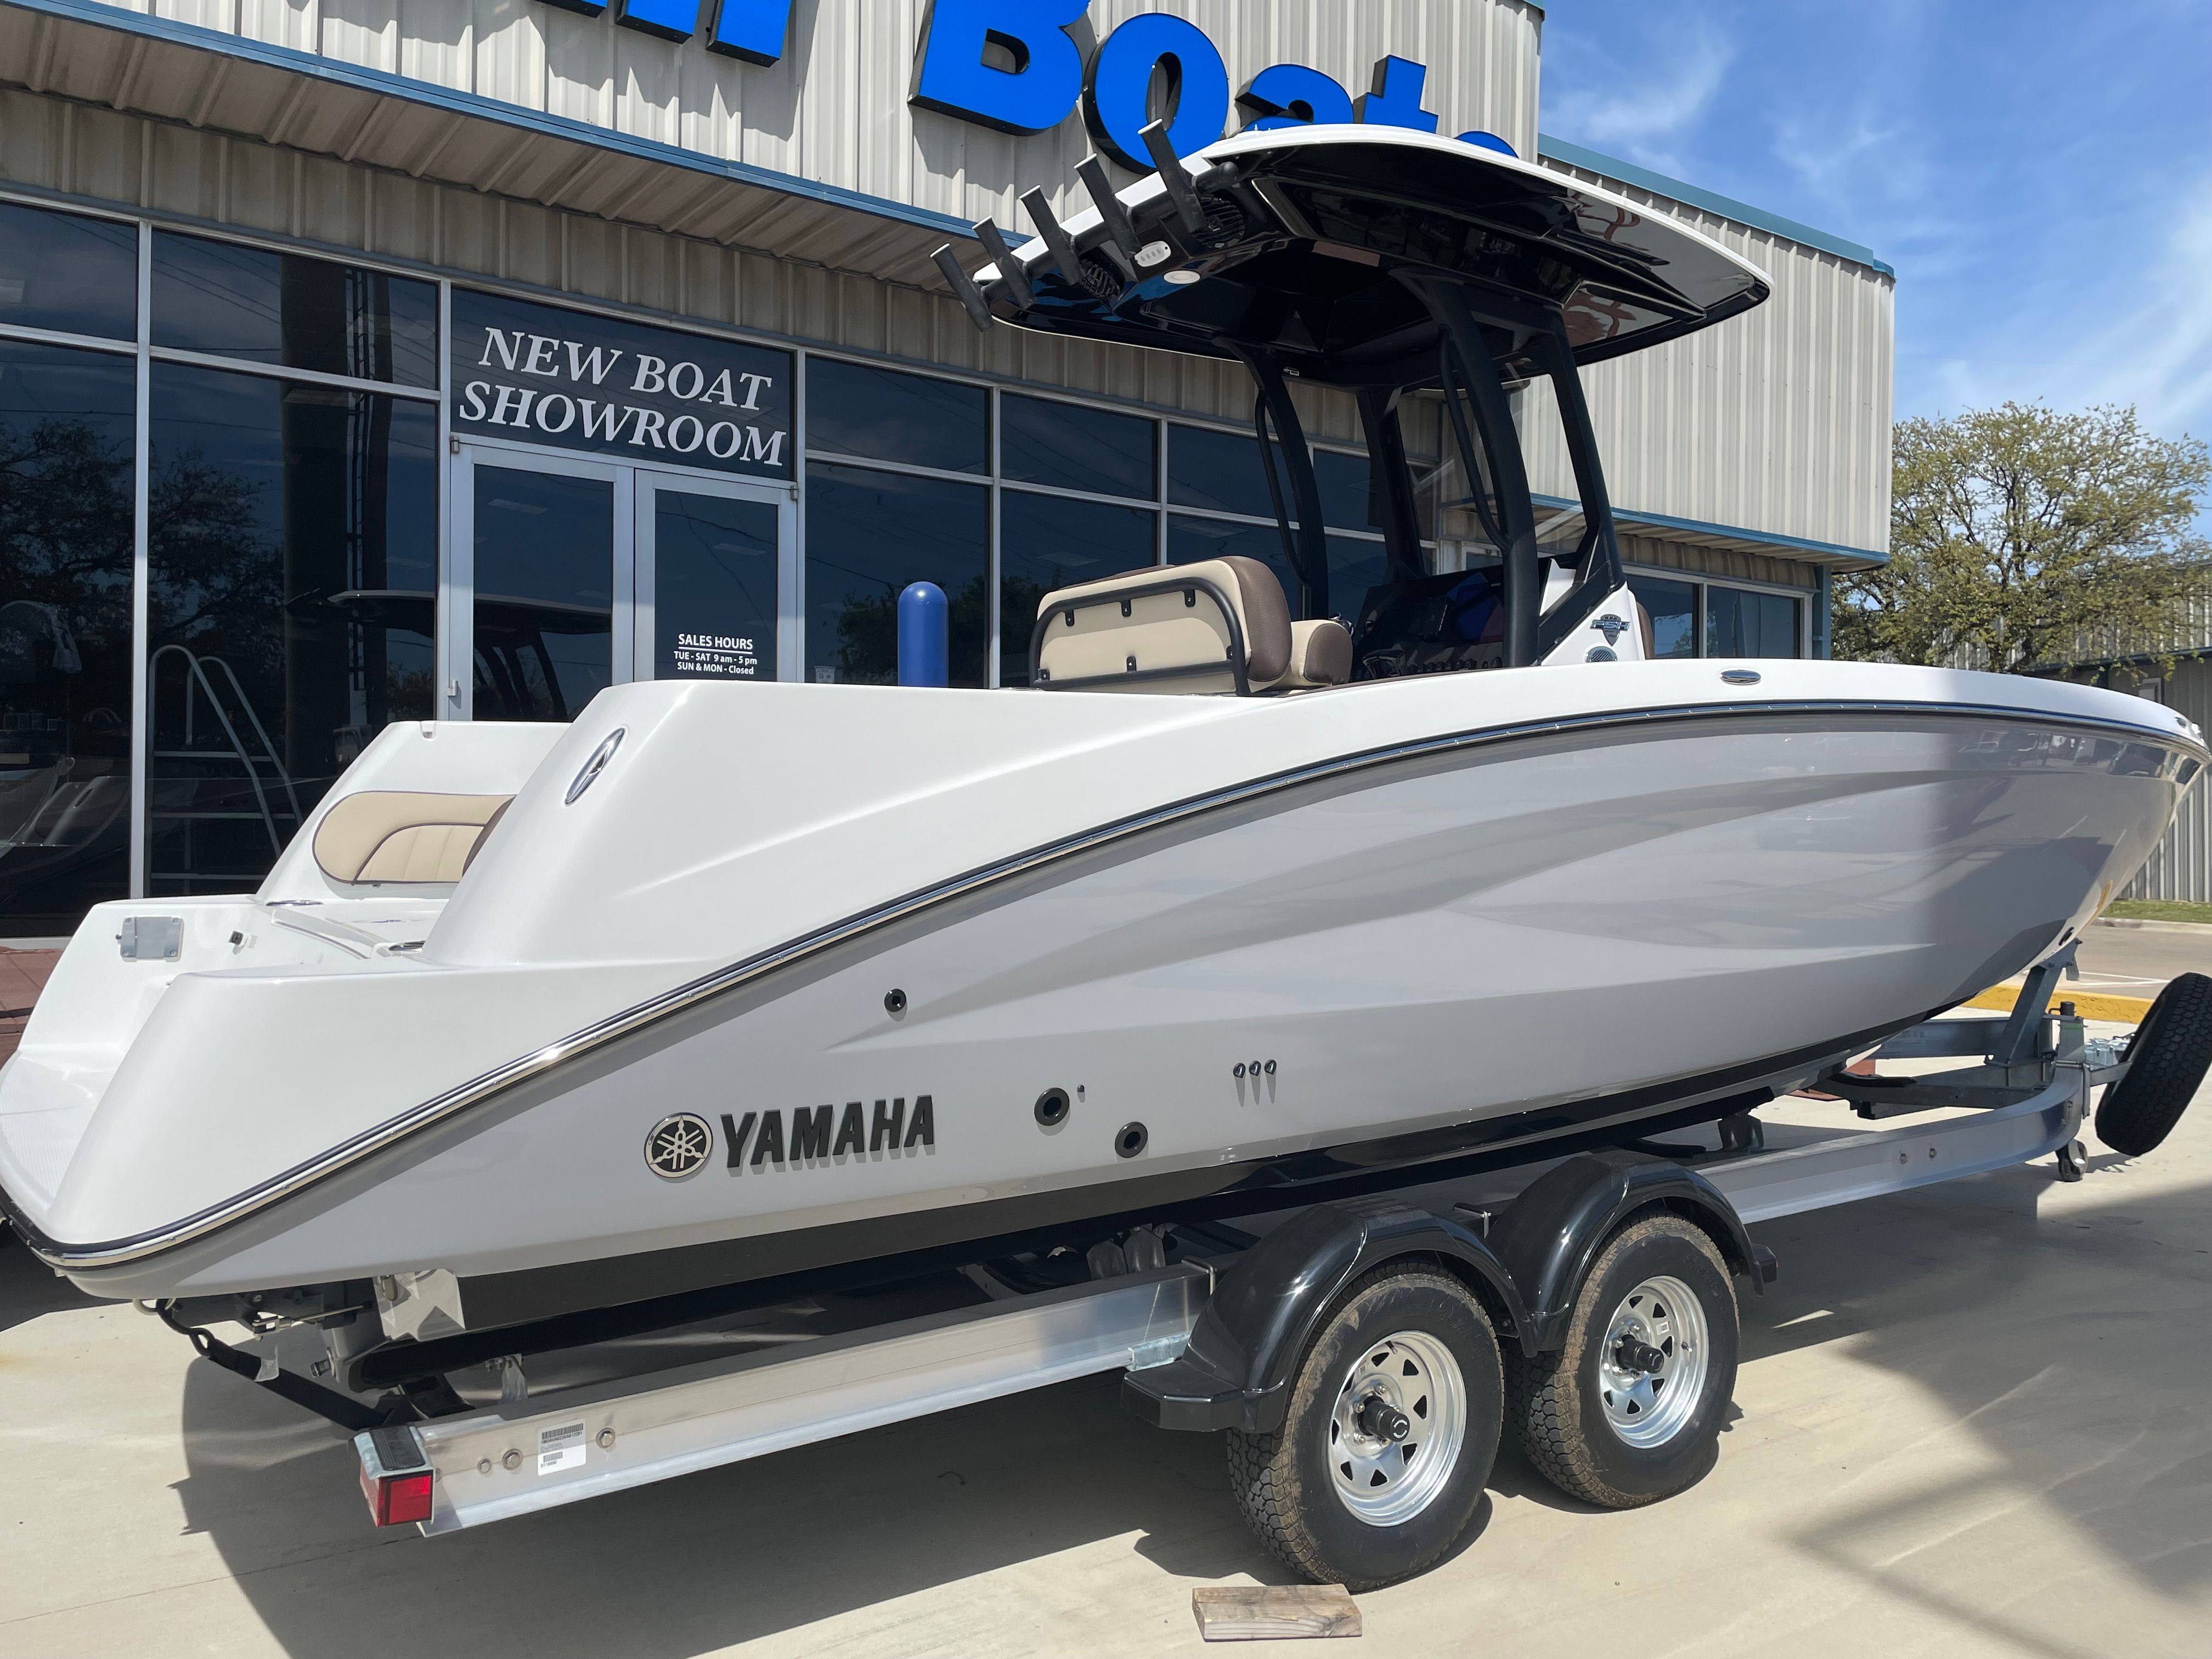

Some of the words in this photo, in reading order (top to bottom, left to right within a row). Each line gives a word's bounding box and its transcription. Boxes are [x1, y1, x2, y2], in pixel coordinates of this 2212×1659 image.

[908, 0, 1520, 174] Boat
[478, 326, 622, 385] NEW
[630, 353, 772, 411] BOAT
[459, 381, 787, 466] SHOWROOM
[674, 651, 690, 660] TUE
[695, 652, 711, 662] SAT
[714, 654, 719, 662] 9
[738, 656, 743, 664] 5
[744, 658, 758, 666] pm
[677, 662, 694, 670] SUN
[696, 663, 702, 672] &
[703, 663, 723, 673] MON
[729, 665, 754, 675] Closed
[678, 634, 712, 647] SALES
[715, 636, 753, 650] HOURS
[720, 1094, 934, 1167] YAMAHA
